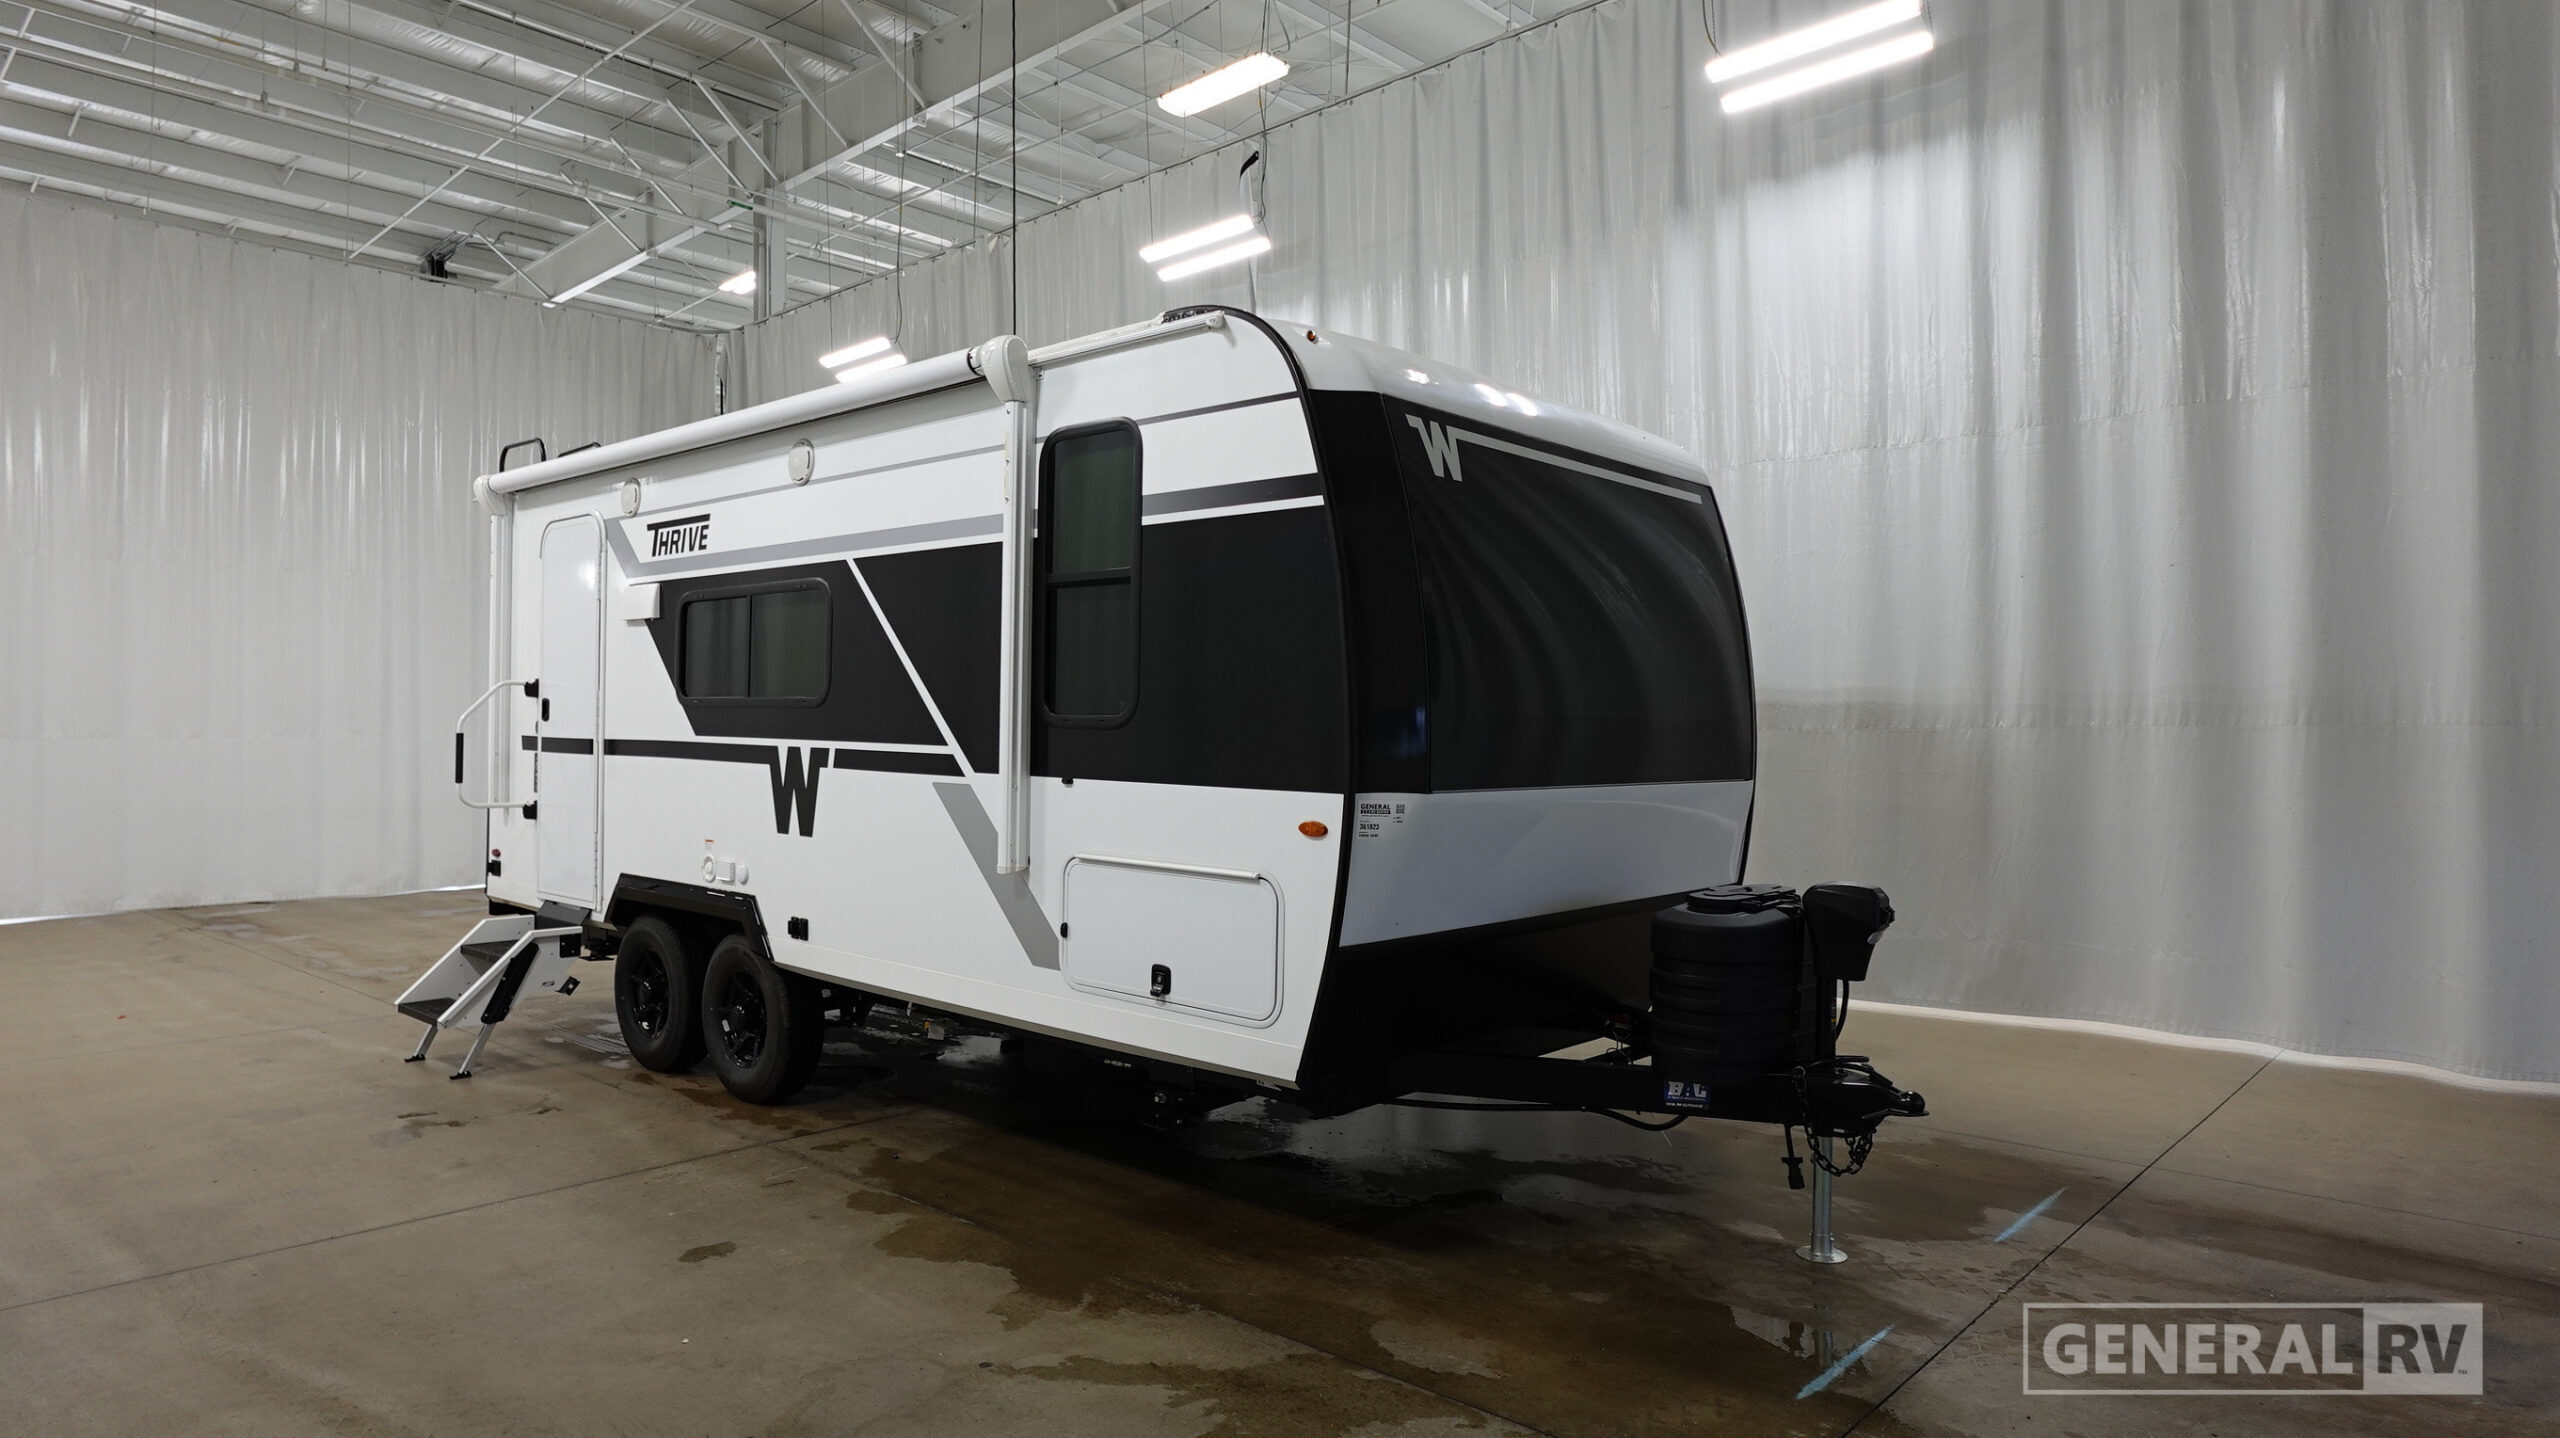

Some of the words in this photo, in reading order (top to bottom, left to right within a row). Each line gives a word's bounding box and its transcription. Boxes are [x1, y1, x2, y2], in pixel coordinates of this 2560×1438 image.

[1404, 413, 1463, 482] W
[647, 513, 711, 557] THRIVE
[767, 746, 830, 838] W
